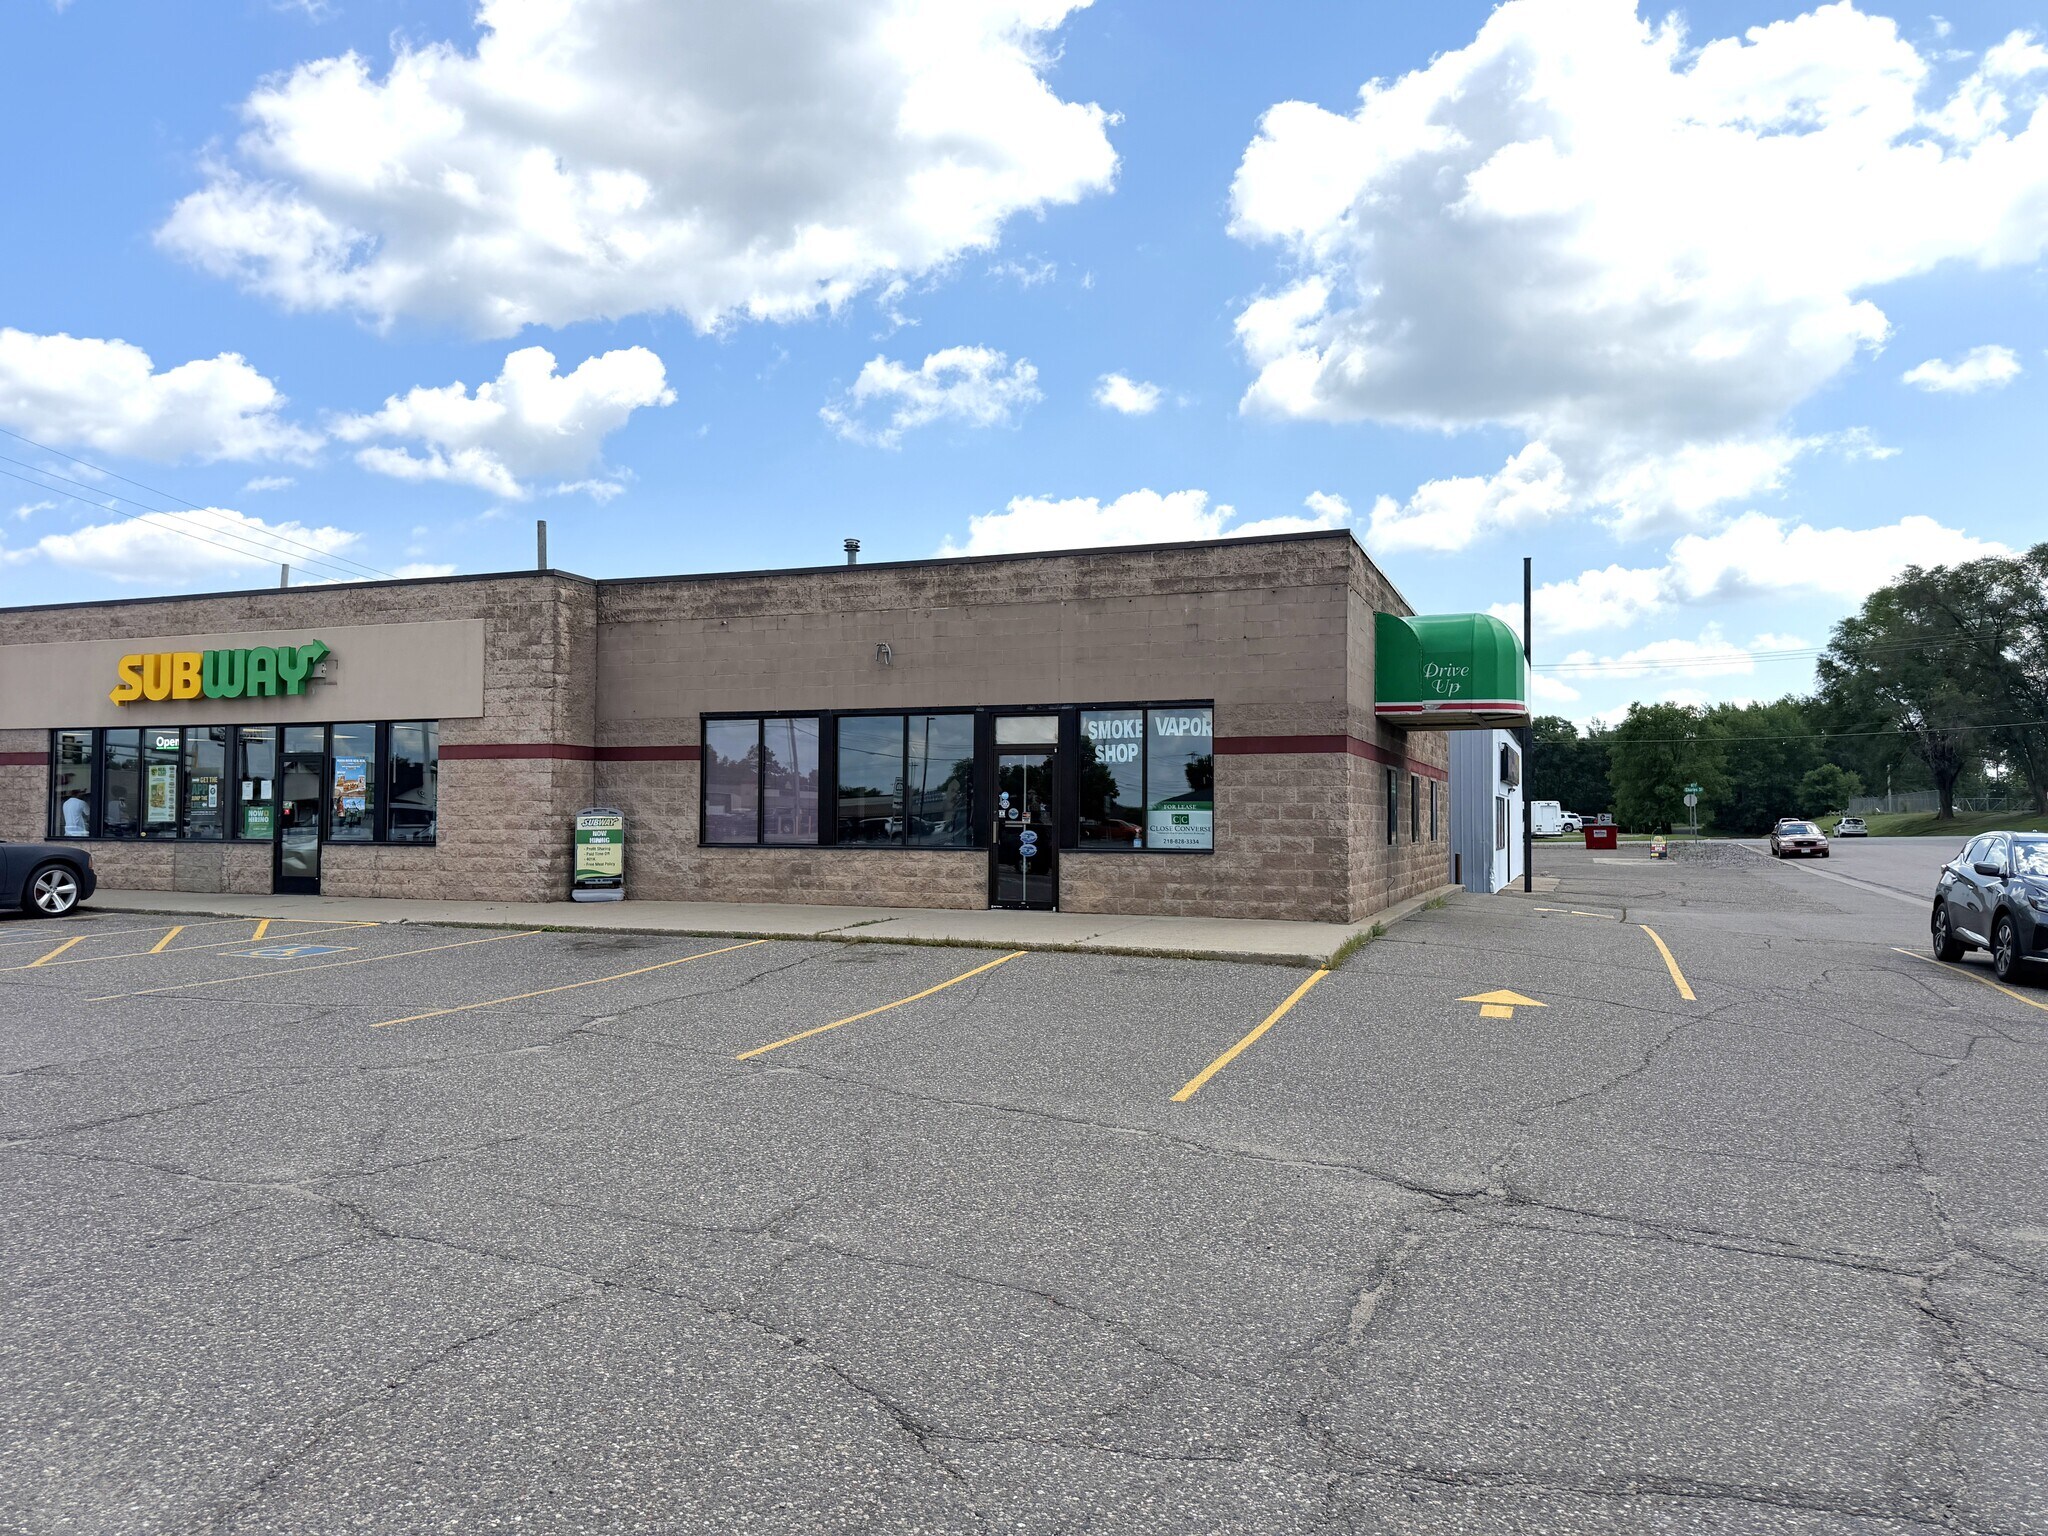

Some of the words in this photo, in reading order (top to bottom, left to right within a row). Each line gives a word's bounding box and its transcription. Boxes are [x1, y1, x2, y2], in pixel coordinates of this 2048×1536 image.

[109, 639, 330, 706] SUBWAY
[1423, 662, 1469, 679] Drive
[1432, 679, 1461, 697] Up
[1088, 719, 1142, 740] SMOKE
[1155, 717, 1212, 736] VAPOR
[1094, 743, 1138, 762] SHOP
[581, 817, 619, 827] SUBWAY
